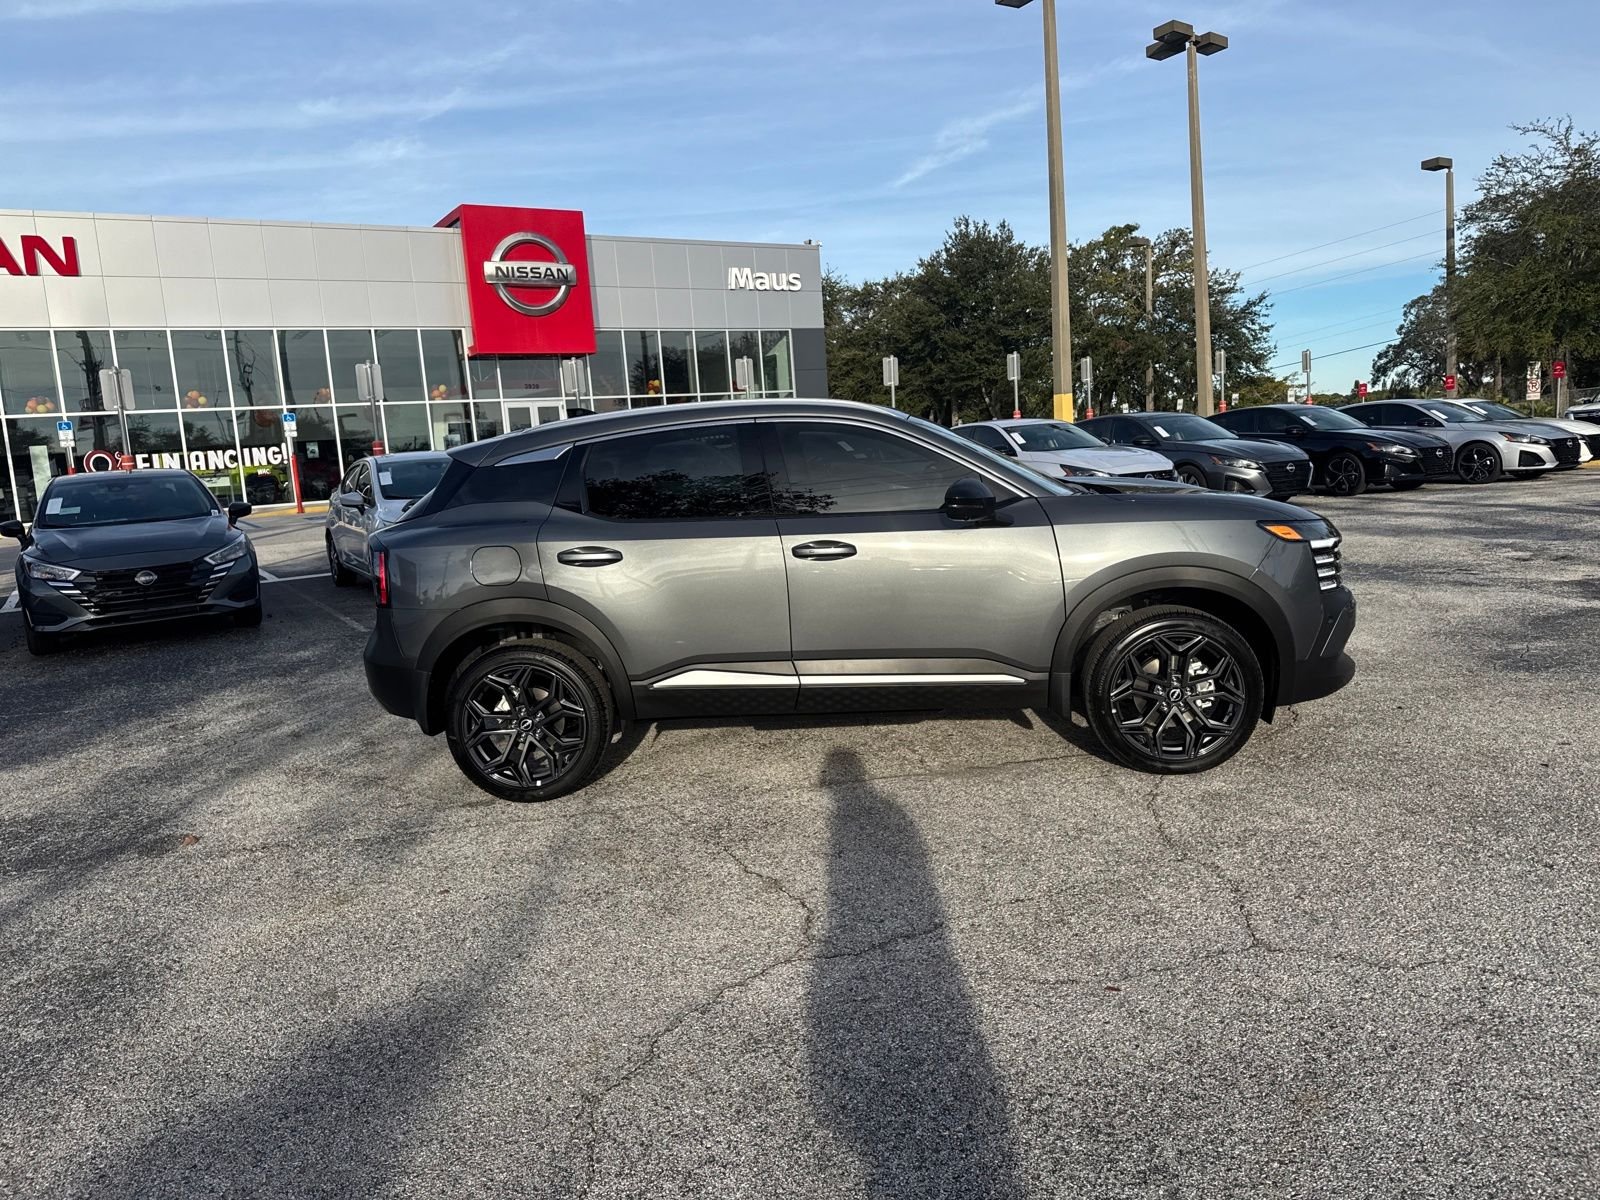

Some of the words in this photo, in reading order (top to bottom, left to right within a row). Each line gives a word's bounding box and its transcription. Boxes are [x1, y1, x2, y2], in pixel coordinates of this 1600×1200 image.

[495, 266, 569, 280] NISSAN
[728, 267, 802, 291] Maus
[135, 442, 289, 471] FINANCING!
